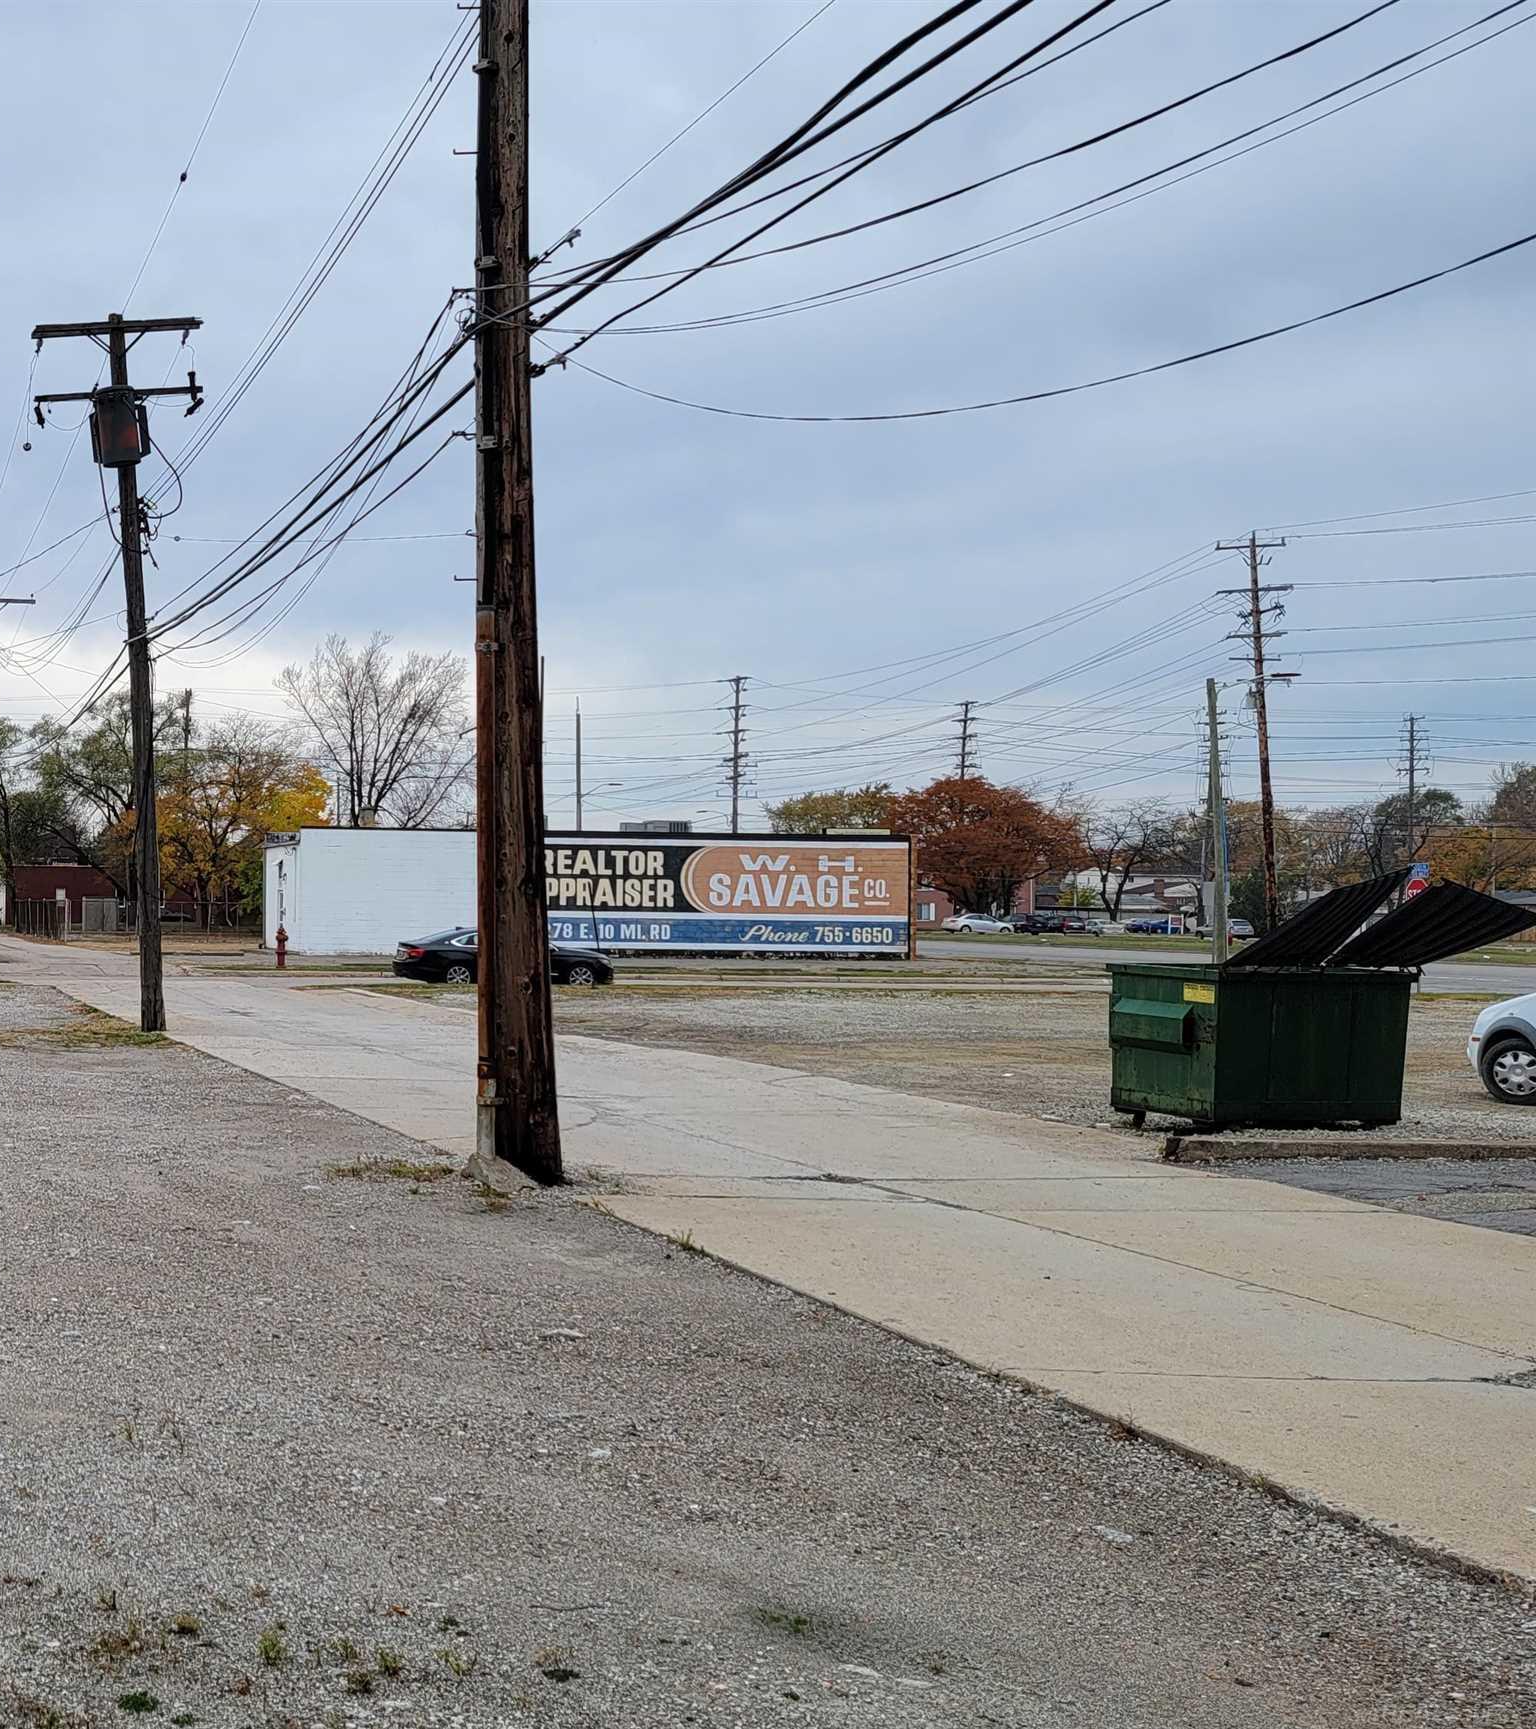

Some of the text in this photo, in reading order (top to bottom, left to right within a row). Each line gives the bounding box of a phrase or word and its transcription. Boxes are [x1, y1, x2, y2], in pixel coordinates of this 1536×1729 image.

[544, 849, 665, 876] REALTOR
[738, 853, 864, 873] W. H.
[545, 877, 675, 908] PPRAISER
[708, 873, 891, 908] SAVAGE CO.
[548, 922, 573, 939] 78
[579, 923, 594, 939] E.
[598, 923, 615, 939] 10
[650, 924, 671, 940] RD
[738, 924, 810, 942] Phone
